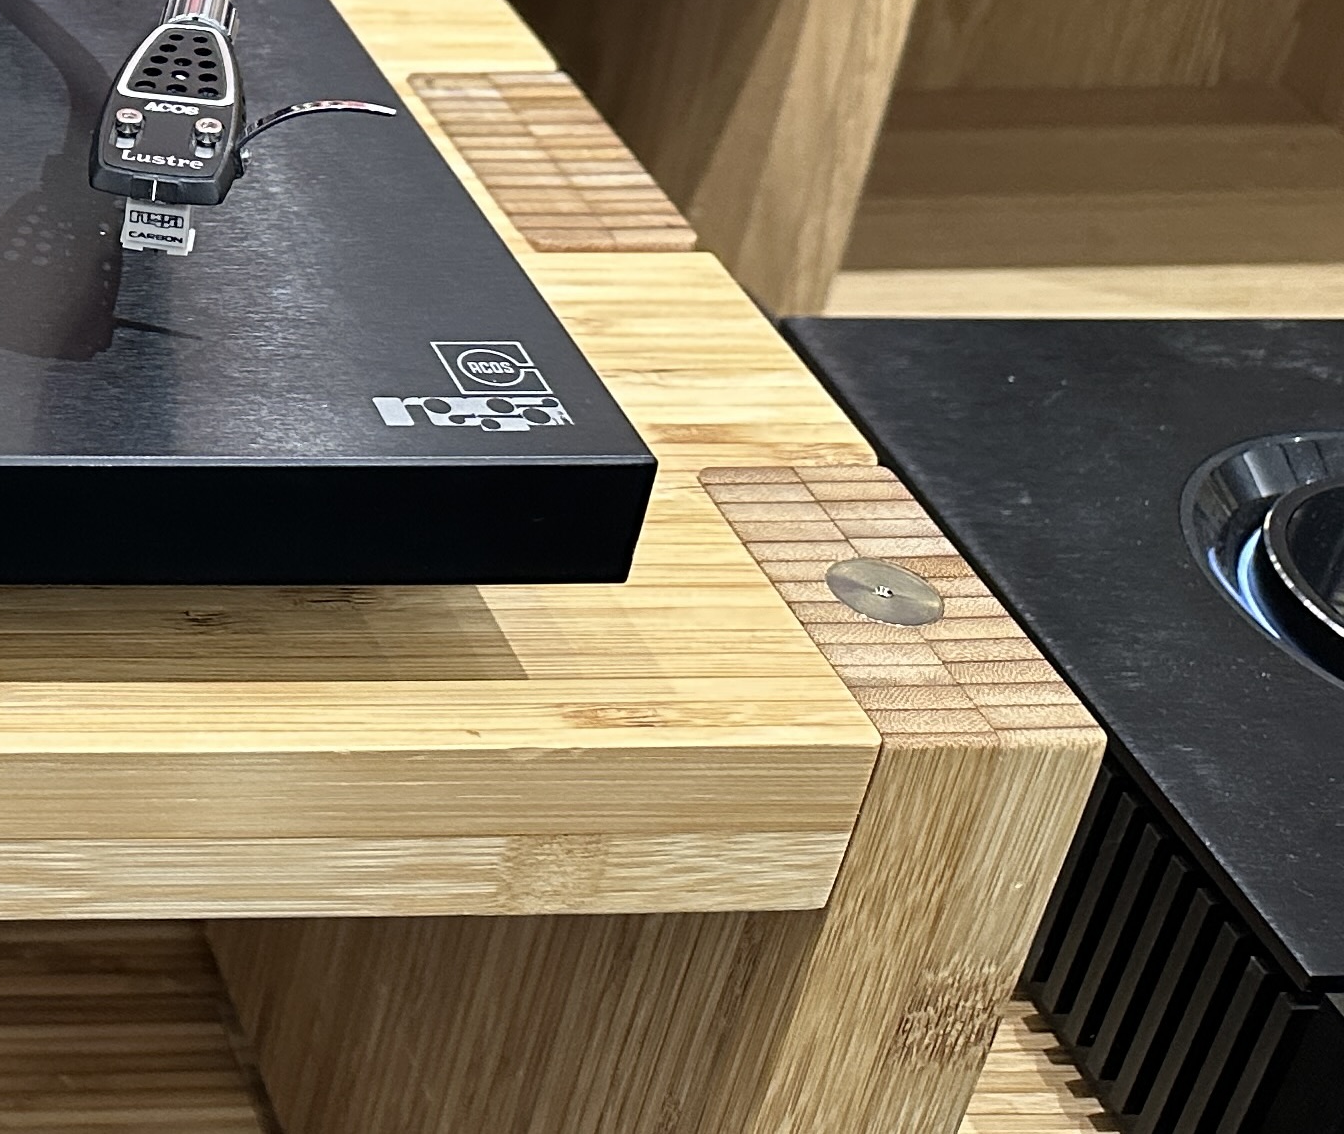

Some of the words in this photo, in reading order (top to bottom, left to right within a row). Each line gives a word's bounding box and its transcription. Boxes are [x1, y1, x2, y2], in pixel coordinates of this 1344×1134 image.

[144, 102, 199, 115] ACOS
[121, 149, 204, 170] Lustre
[128, 230, 183, 244] CARBON
[466, 361, 516, 374] ACOS
